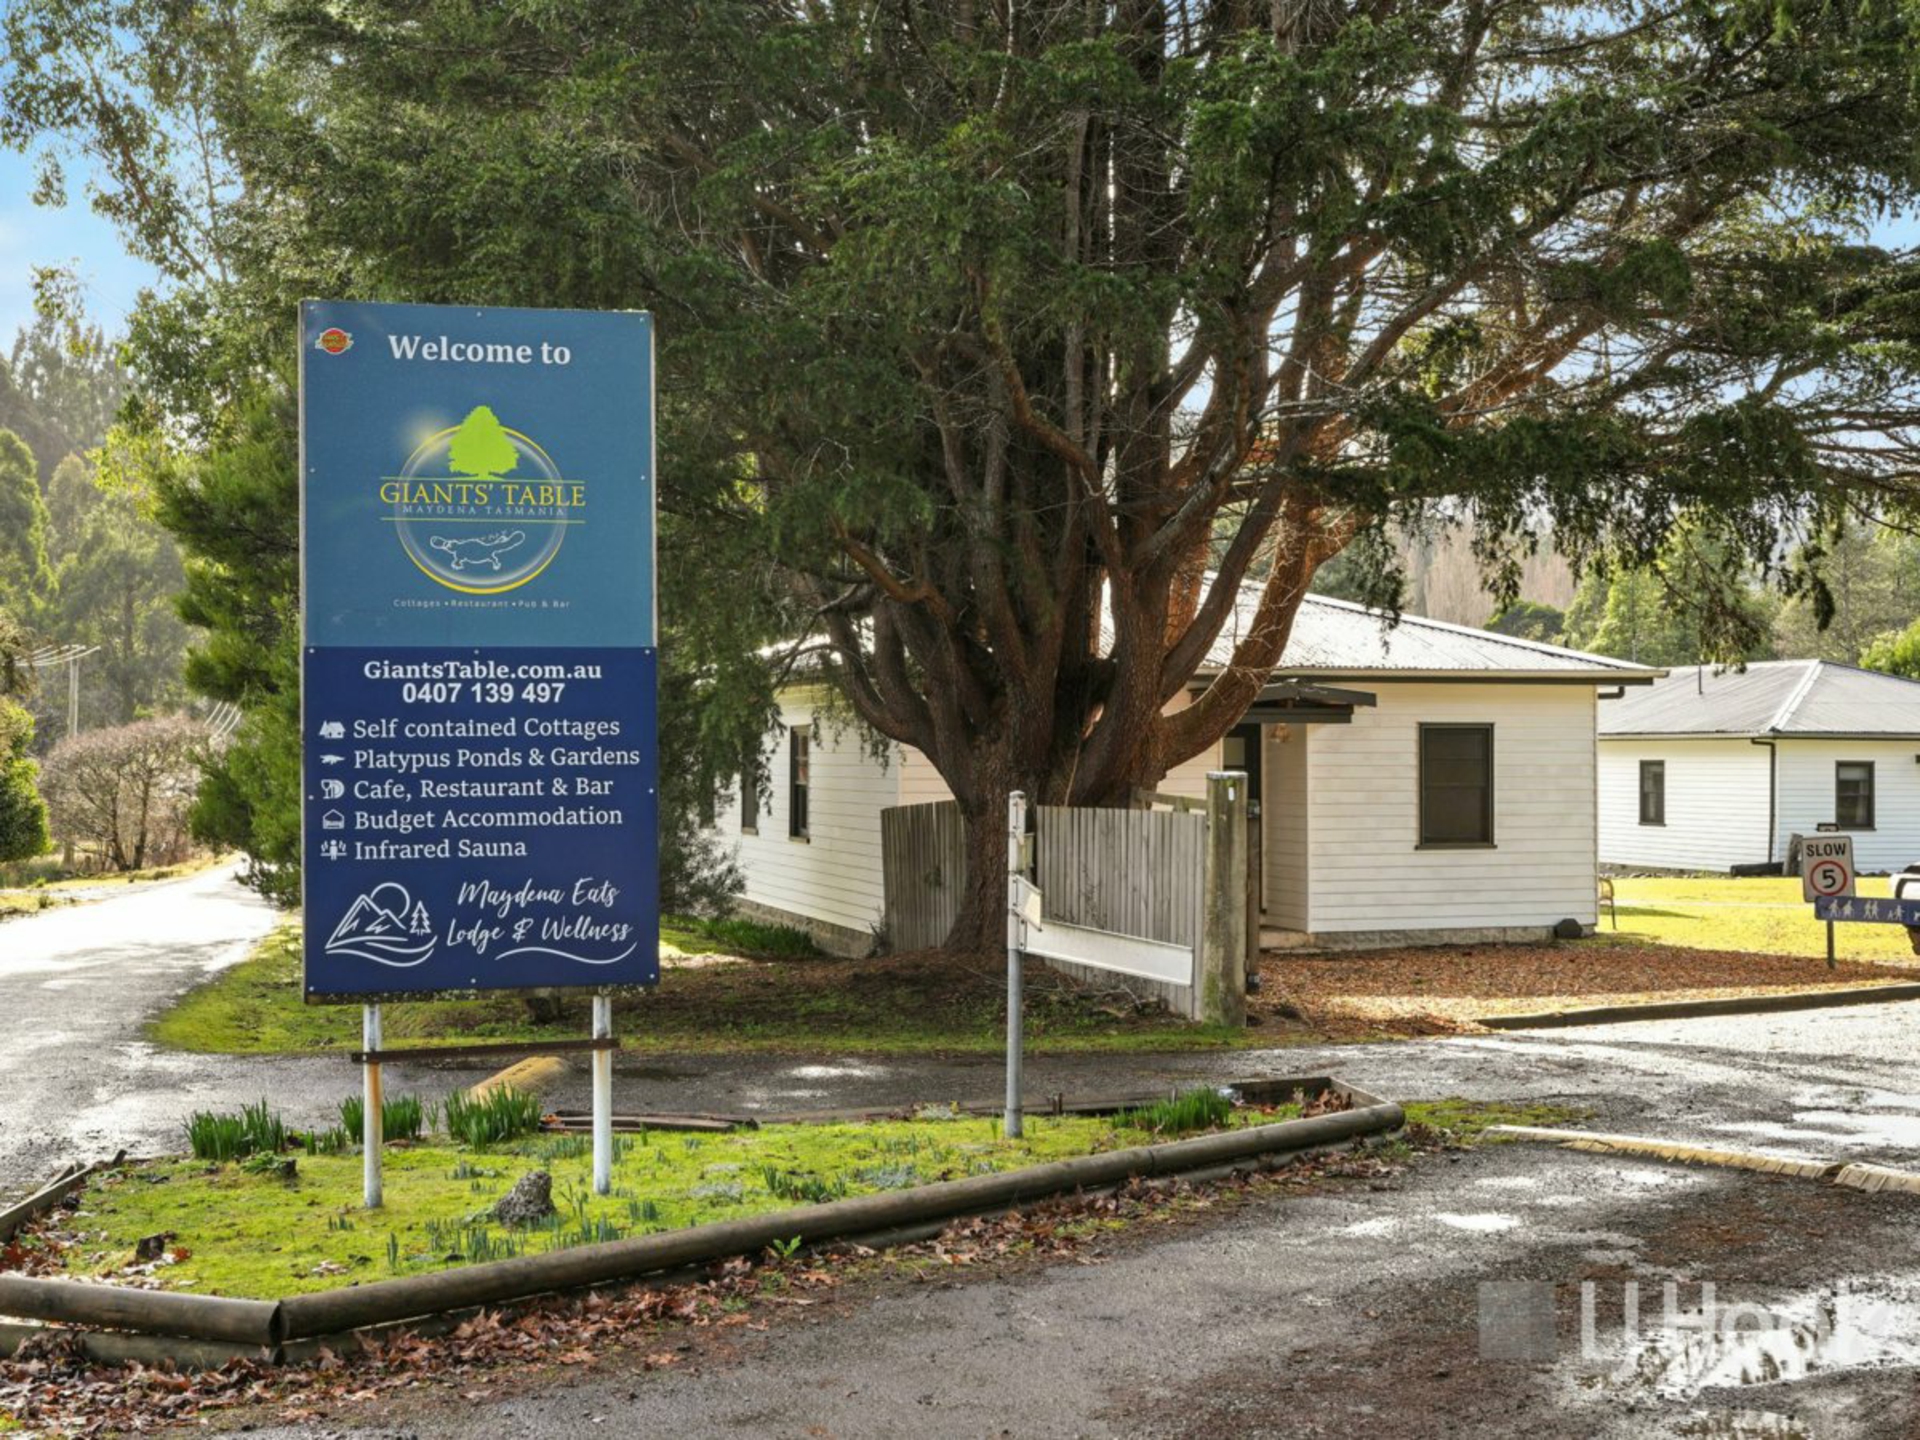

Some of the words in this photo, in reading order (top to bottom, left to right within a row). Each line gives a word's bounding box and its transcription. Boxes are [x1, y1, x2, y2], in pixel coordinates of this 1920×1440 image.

[388, 334, 533, 364] Welcome
[541, 342, 571, 365] to
[379, 482, 495, 505] GIANTS'
[502, 484, 587, 507] TABLE
[402, 505, 478, 515] MAYDENA
[486, 506, 566, 517] TASMANIA
[392, 599, 440, 609] Cottages
[450, 599, 508, 609] Restaurant
[518, 600, 538, 609] Pub
[552, 601, 571, 609] Bar
[363, 660, 602, 680] GiantsTable.com.au
[402, 682, 463, 703] 0407
[470, 682, 514, 702] 139
[521, 682, 566, 702] 497
[353, 718, 399, 738] Self
[404, 718, 517, 738] contained
[523, 717, 621, 740] Cottages
[353, 749, 451, 773] Platypus
[456, 748, 523, 768] Ponds
[528, 747, 545, 766] &
[550, 746, 641, 767] Gardens
[353, 780, 413, 802] Cafe,
[420, 778, 545, 799] Restaurant
[551, 777, 569, 797] &
[575, 777, 614, 796] Bar
[354, 810, 435, 834] Budget
[442, 806, 623, 829] Accommodation
[354, 839, 451, 861] Infrared
[457, 839, 528, 858] Sauna
[1807, 843, 1846, 857] SLOW
[1822, 869, 1836, 889] 5
[457, 879, 564, 919] Maydena
[571, 877, 619, 907] Eats
[446, 918, 505, 954] Lodge
[512, 919, 535, 942] &
[541, 914, 635, 942] Wellness
